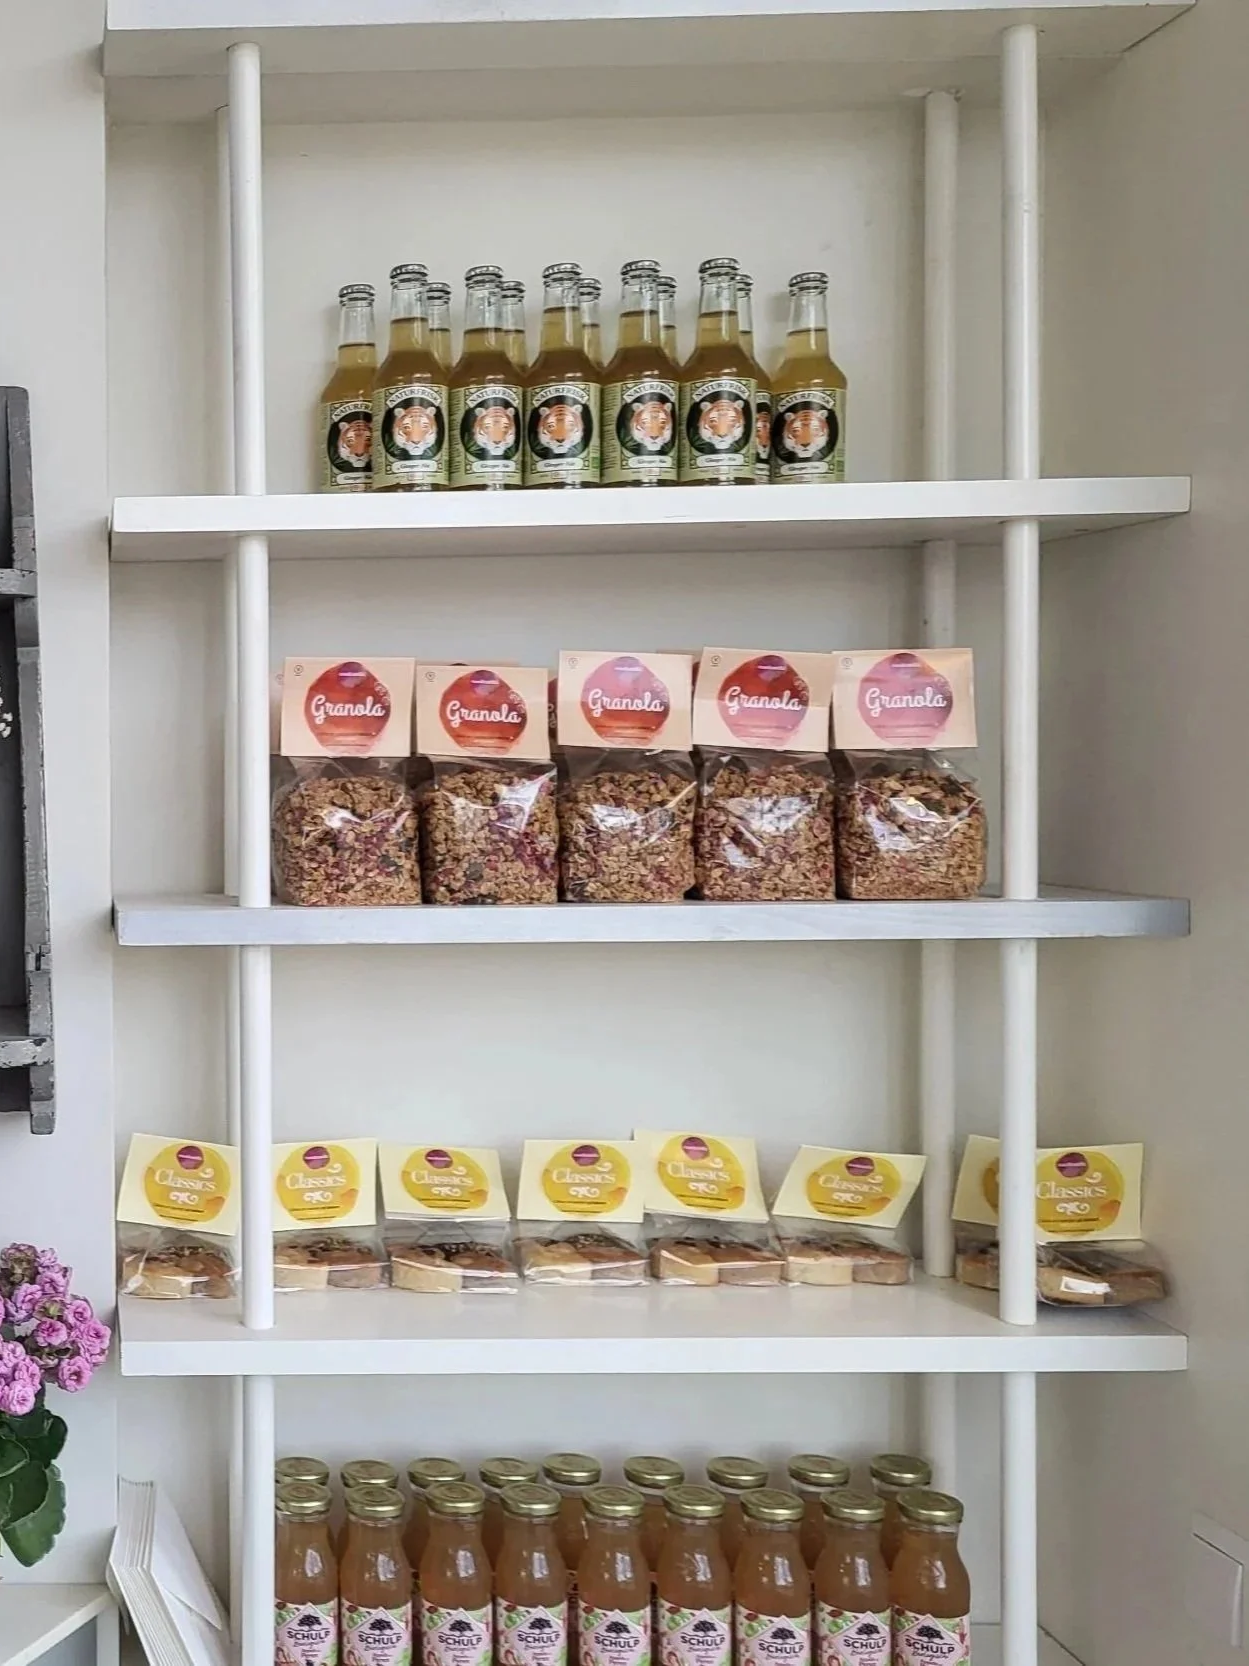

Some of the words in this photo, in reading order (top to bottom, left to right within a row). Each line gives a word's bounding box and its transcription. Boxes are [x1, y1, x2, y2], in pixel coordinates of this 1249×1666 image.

[311, 694, 385, 724] Granola
[588, 689, 665, 717] Granola
[725, 686, 801, 716] Granola
[865, 687, 947, 717] Granola
[446, 700, 522, 728] Granola
[155, 1168, 217, 1191] Classics
[411, 1170, 474, 1188] Classics
[551, 1168, 617, 1184] Classics
[666, 1161, 730, 1182] Classics
[285, 1172, 347, 1190] Classics
[818, 1174, 884, 1193] Classics
[1037, 1181, 1107, 1199] Classics
[287, 1630, 330, 1640] SCHULP
[358, 1634, 402, 1645] SCHULP
[438, 1635, 482, 1646] SCHULP
[517, 1633, 560, 1644] SCHULP
[594, 1635, 640, 1648] SCHULP
[680, 1635, 725, 1646] SCHULP
[844, 1639, 886, 1649] SCHULP
[759, 1642, 804, 1654] SCHULP
[905, 1638, 955, 1654] SCHULP
